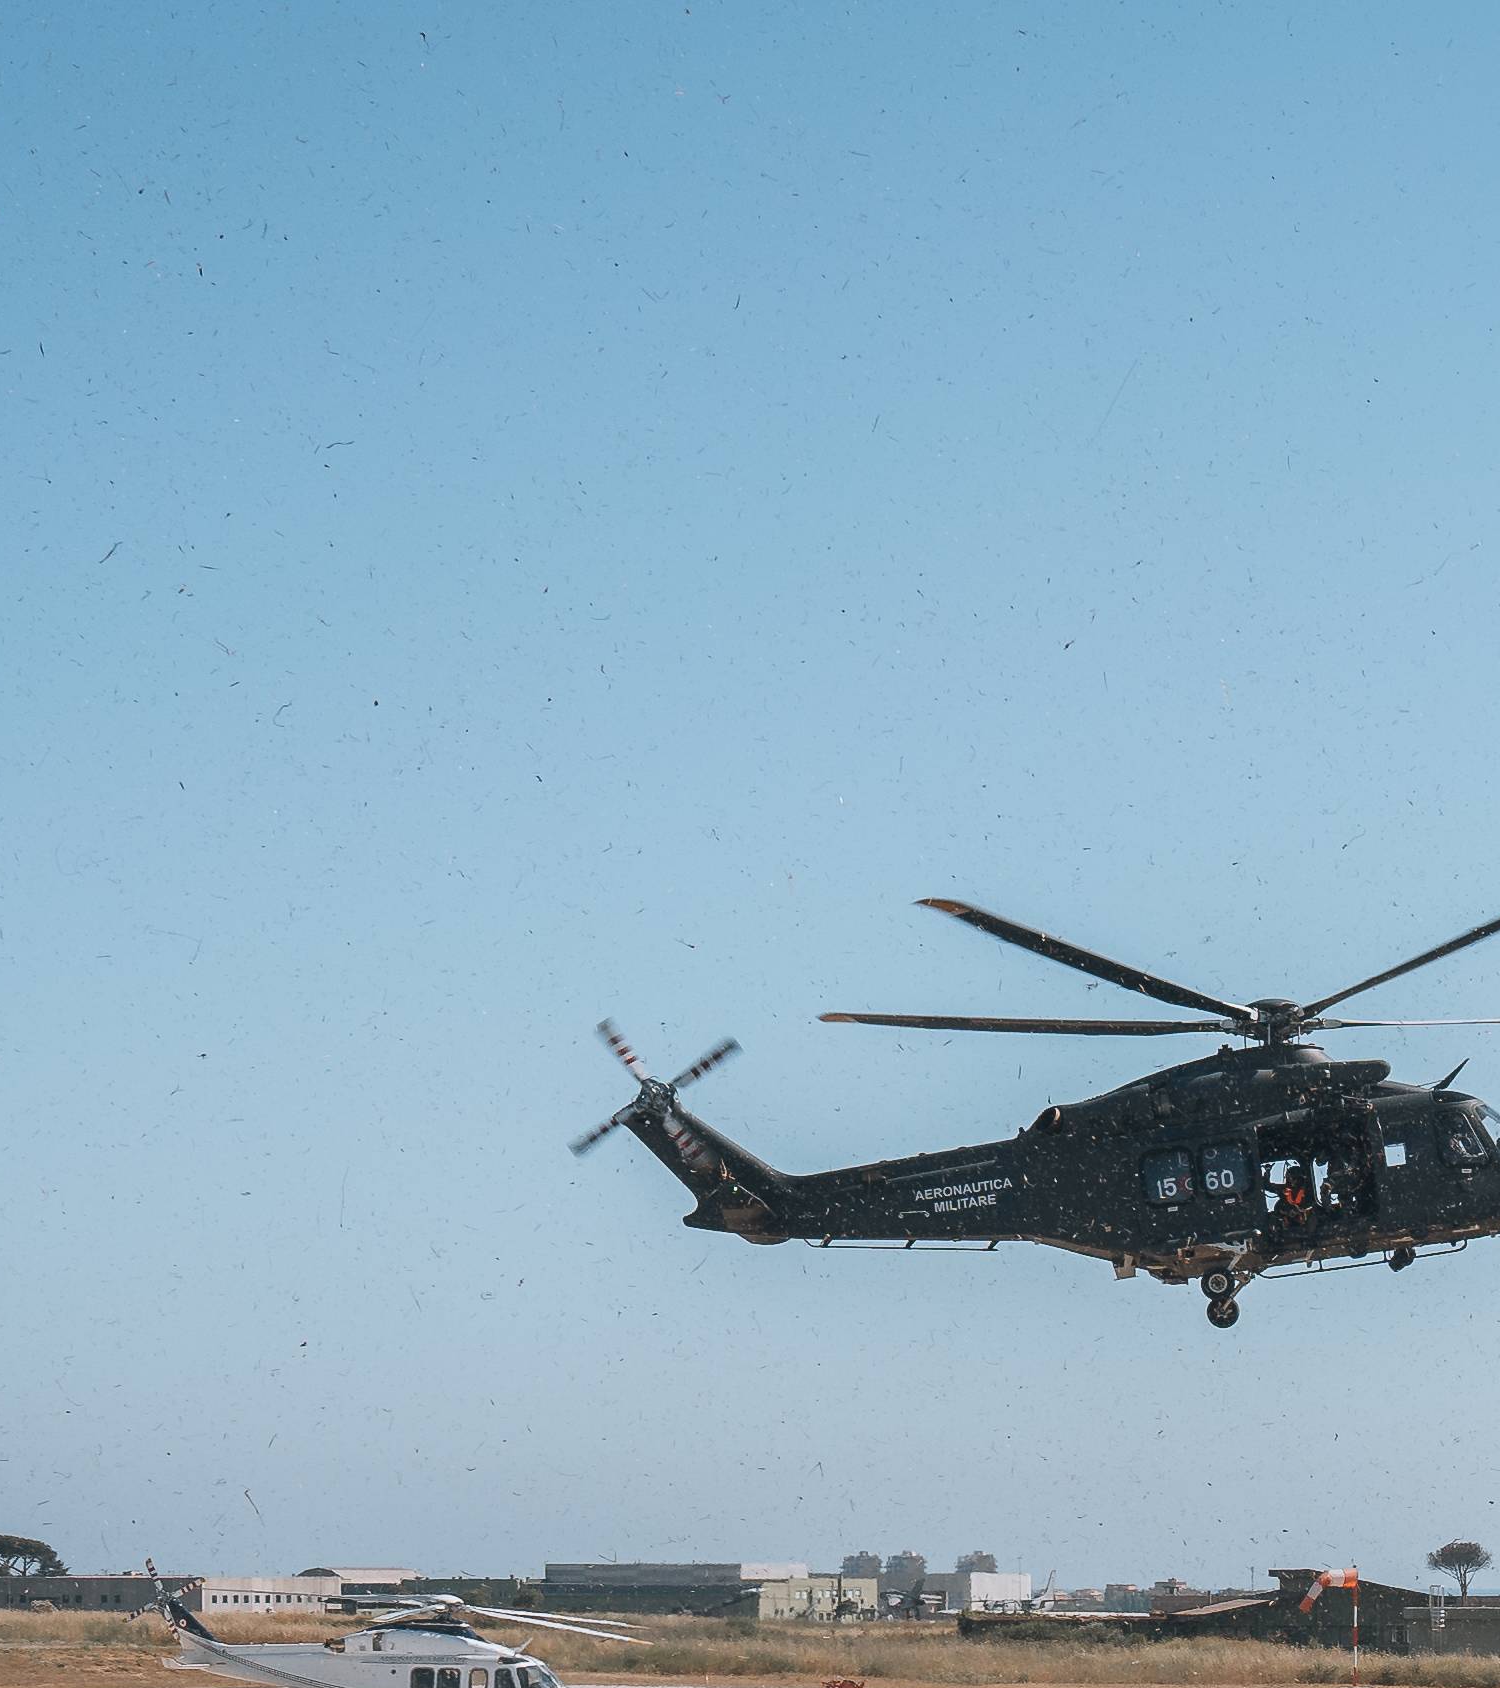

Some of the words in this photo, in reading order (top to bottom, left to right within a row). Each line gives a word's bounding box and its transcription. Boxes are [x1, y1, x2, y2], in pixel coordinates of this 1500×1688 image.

[914, 1177, 1013, 1201] AERONAUTICA
[1205, 1169, 1235, 1191] 60
[934, 1193, 997, 1213] MILITARE
